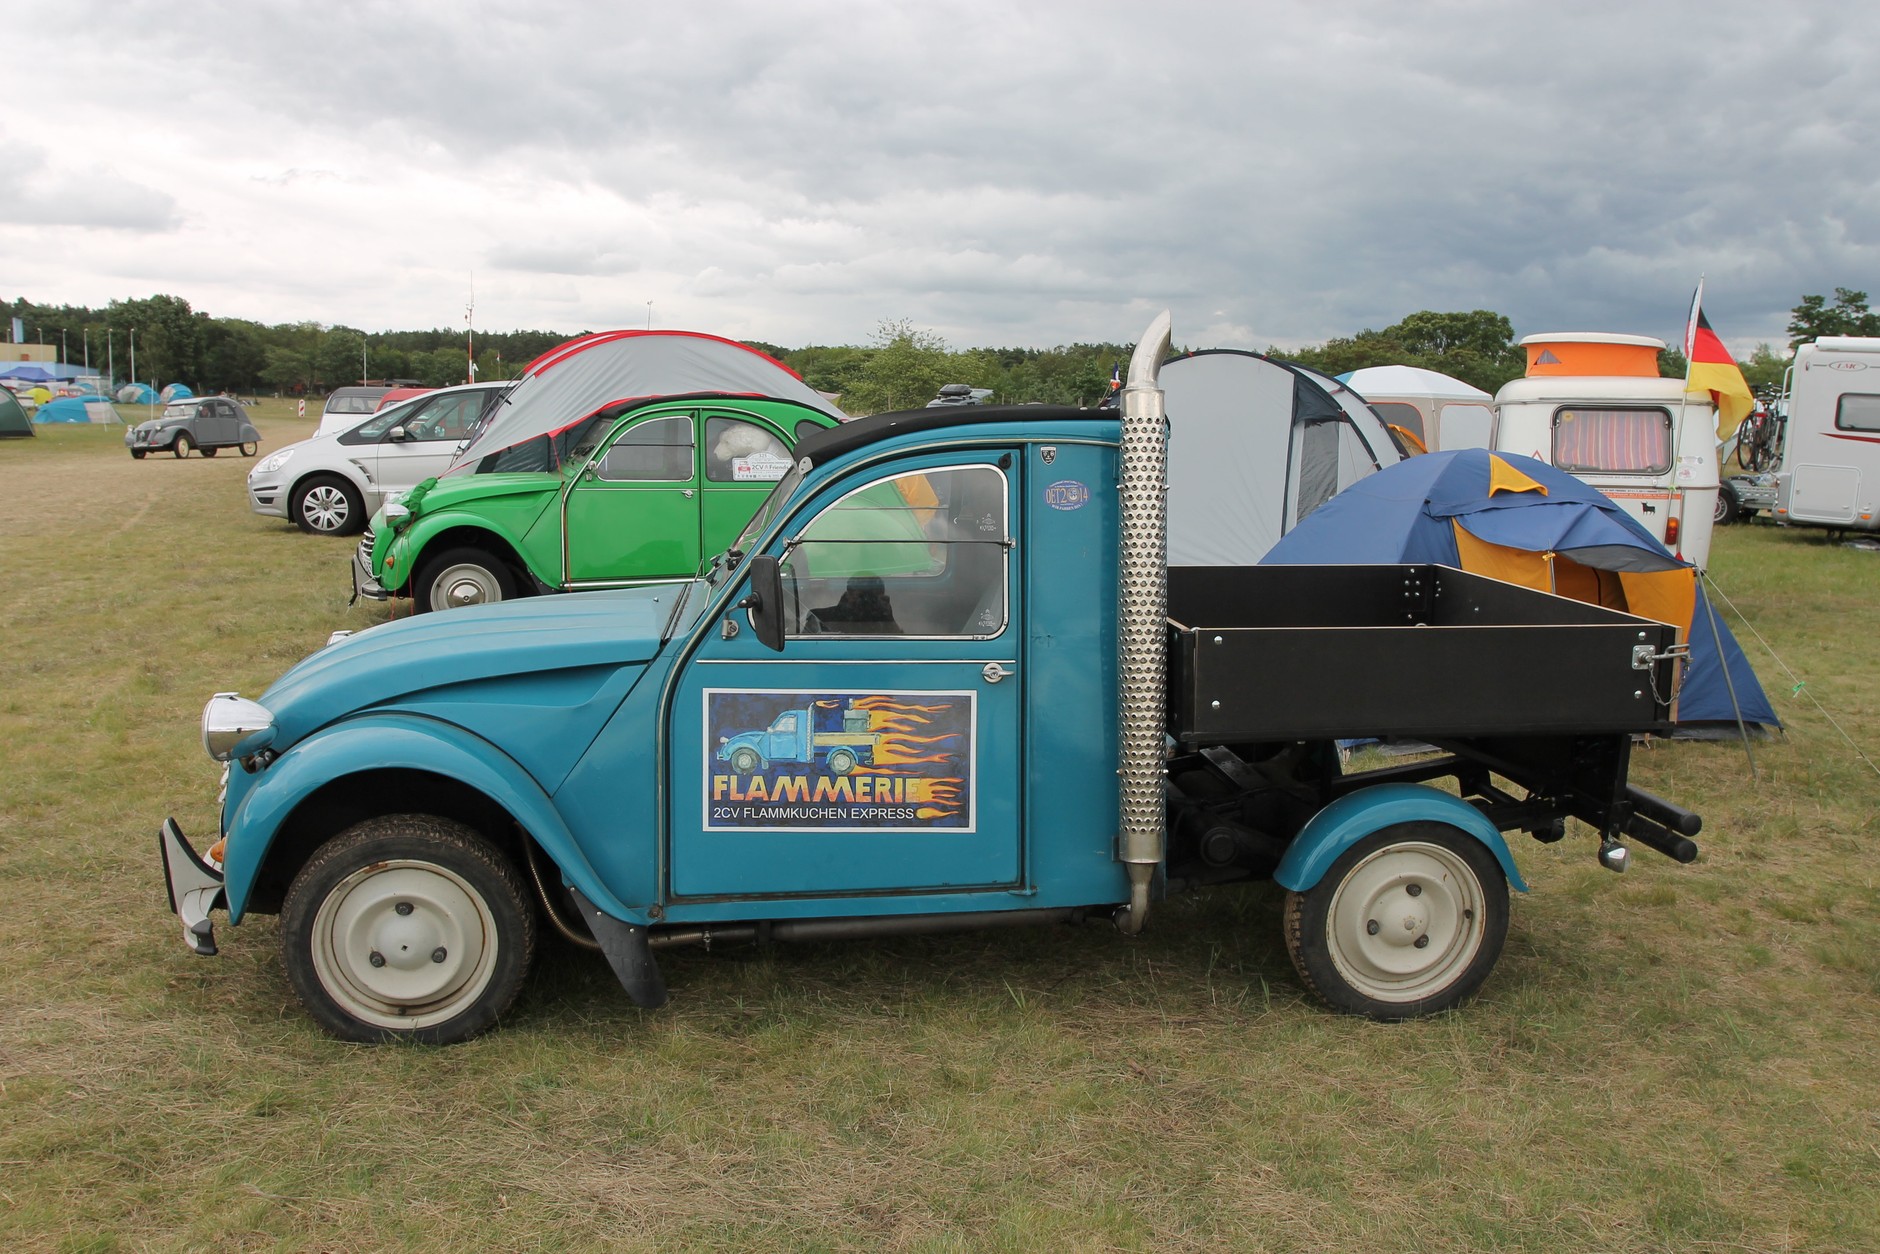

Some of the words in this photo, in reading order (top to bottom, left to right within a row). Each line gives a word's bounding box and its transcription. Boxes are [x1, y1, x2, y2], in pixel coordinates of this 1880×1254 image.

[713, 775, 922, 803] FLAMMERIE
[714, 807, 740, 819] 2CV
[743, 807, 847, 819] FLAMMKUCHEN
[851, 808, 914, 820] EXPRESS
